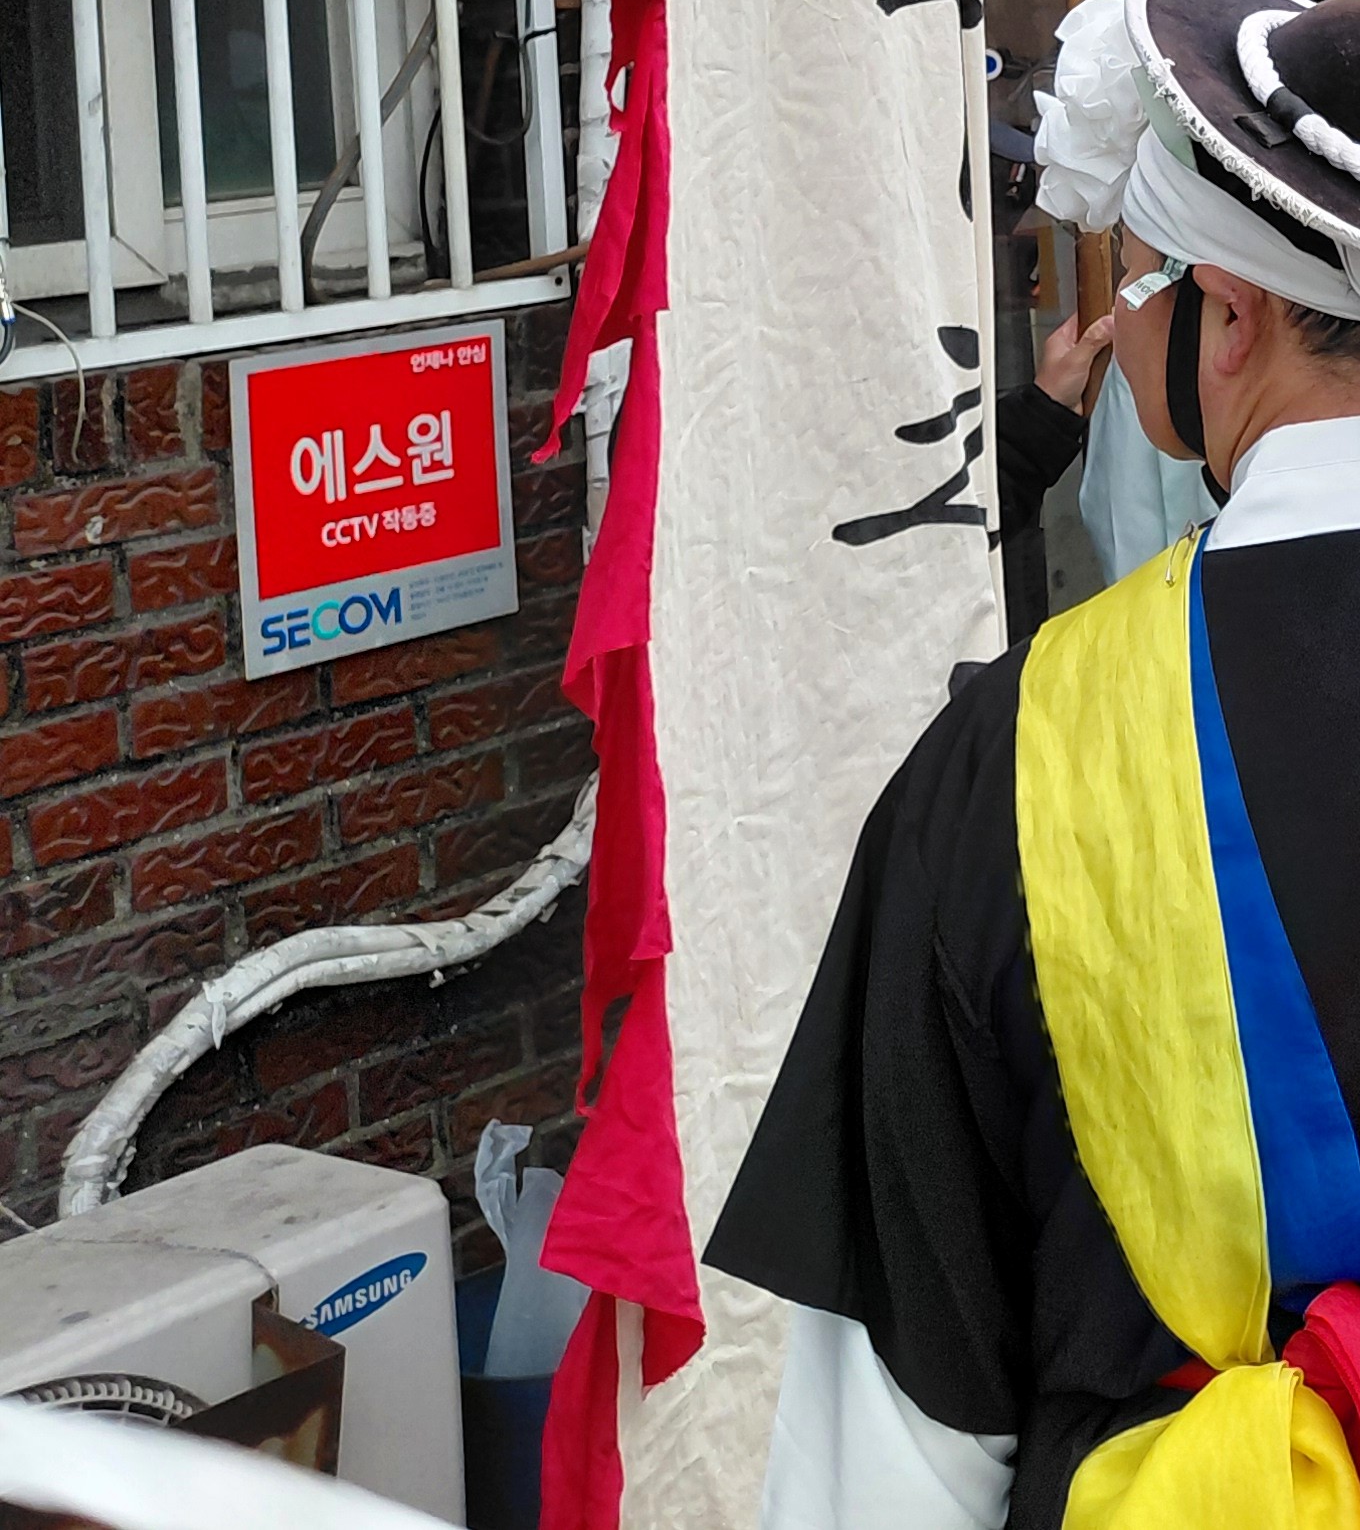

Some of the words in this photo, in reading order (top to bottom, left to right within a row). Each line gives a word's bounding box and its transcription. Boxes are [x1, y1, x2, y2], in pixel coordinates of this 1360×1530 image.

[410, 348, 454, 373] 언제나
[457, 343, 487, 366] 안심
[290, 409, 455, 504] 에스원
[321, 513, 379, 548] CCTV
[382, 502, 437, 533] 작동중
[260, 586, 403, 657] SECOM
[304, 1268, 414, 1331] SAMSUNG
